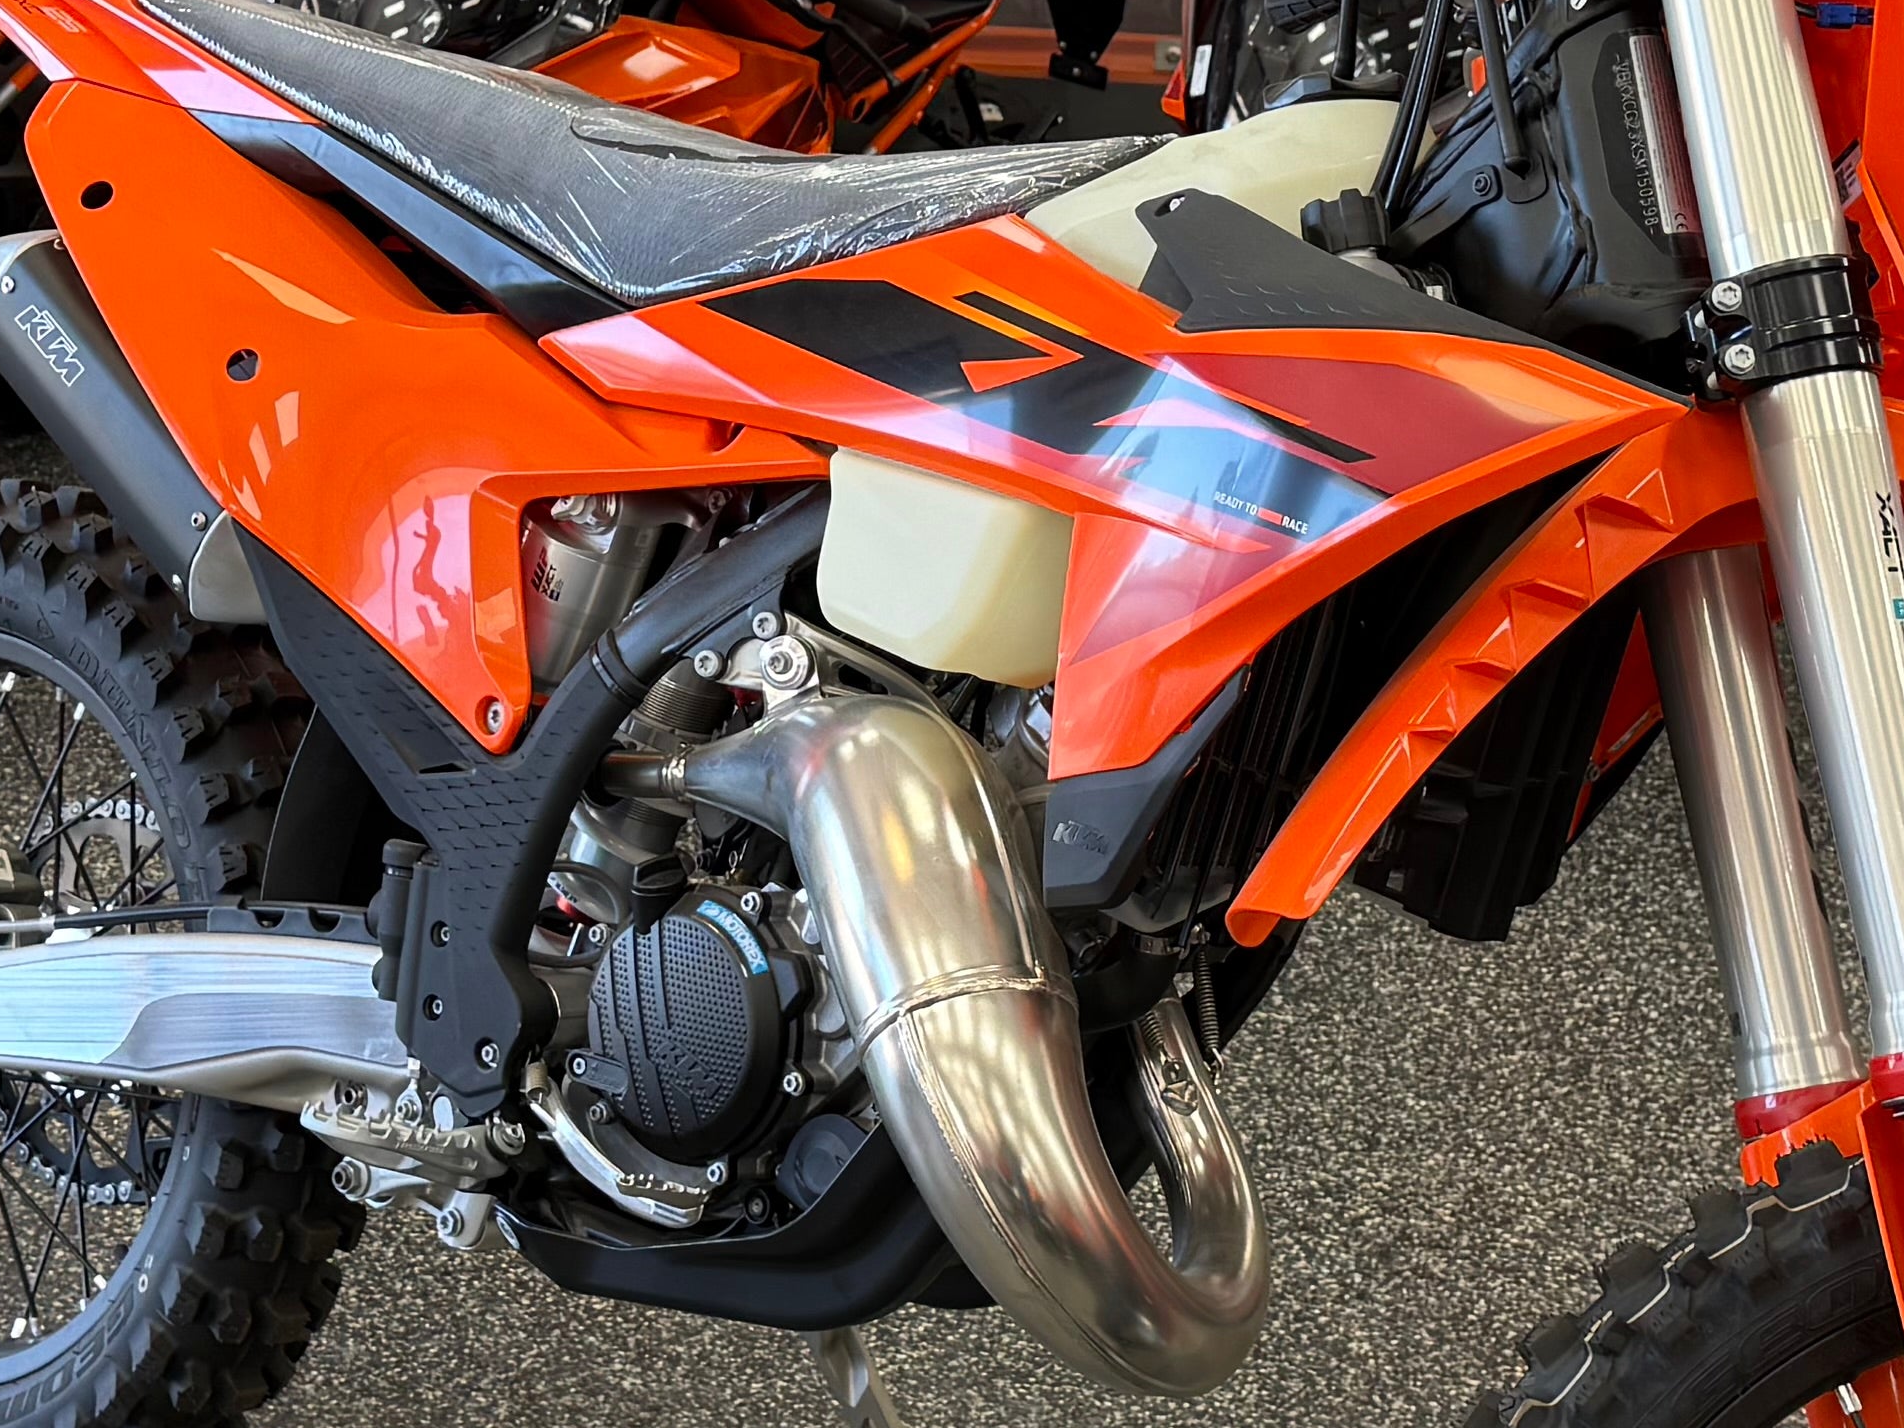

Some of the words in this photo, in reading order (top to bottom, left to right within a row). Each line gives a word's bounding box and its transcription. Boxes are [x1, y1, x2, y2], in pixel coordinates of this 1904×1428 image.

[13, 303, 86, 389] KTM
[1213, 490, 1245, 512] READY
[1245, 500, 1258, 517] TO
[1281, 515, 1309, 535] RACE
[1051, 819, 1110, 855] KTM
[716, 907, 765, 967] MOTOREX
[654, 1041, 722, 1100] KTM
